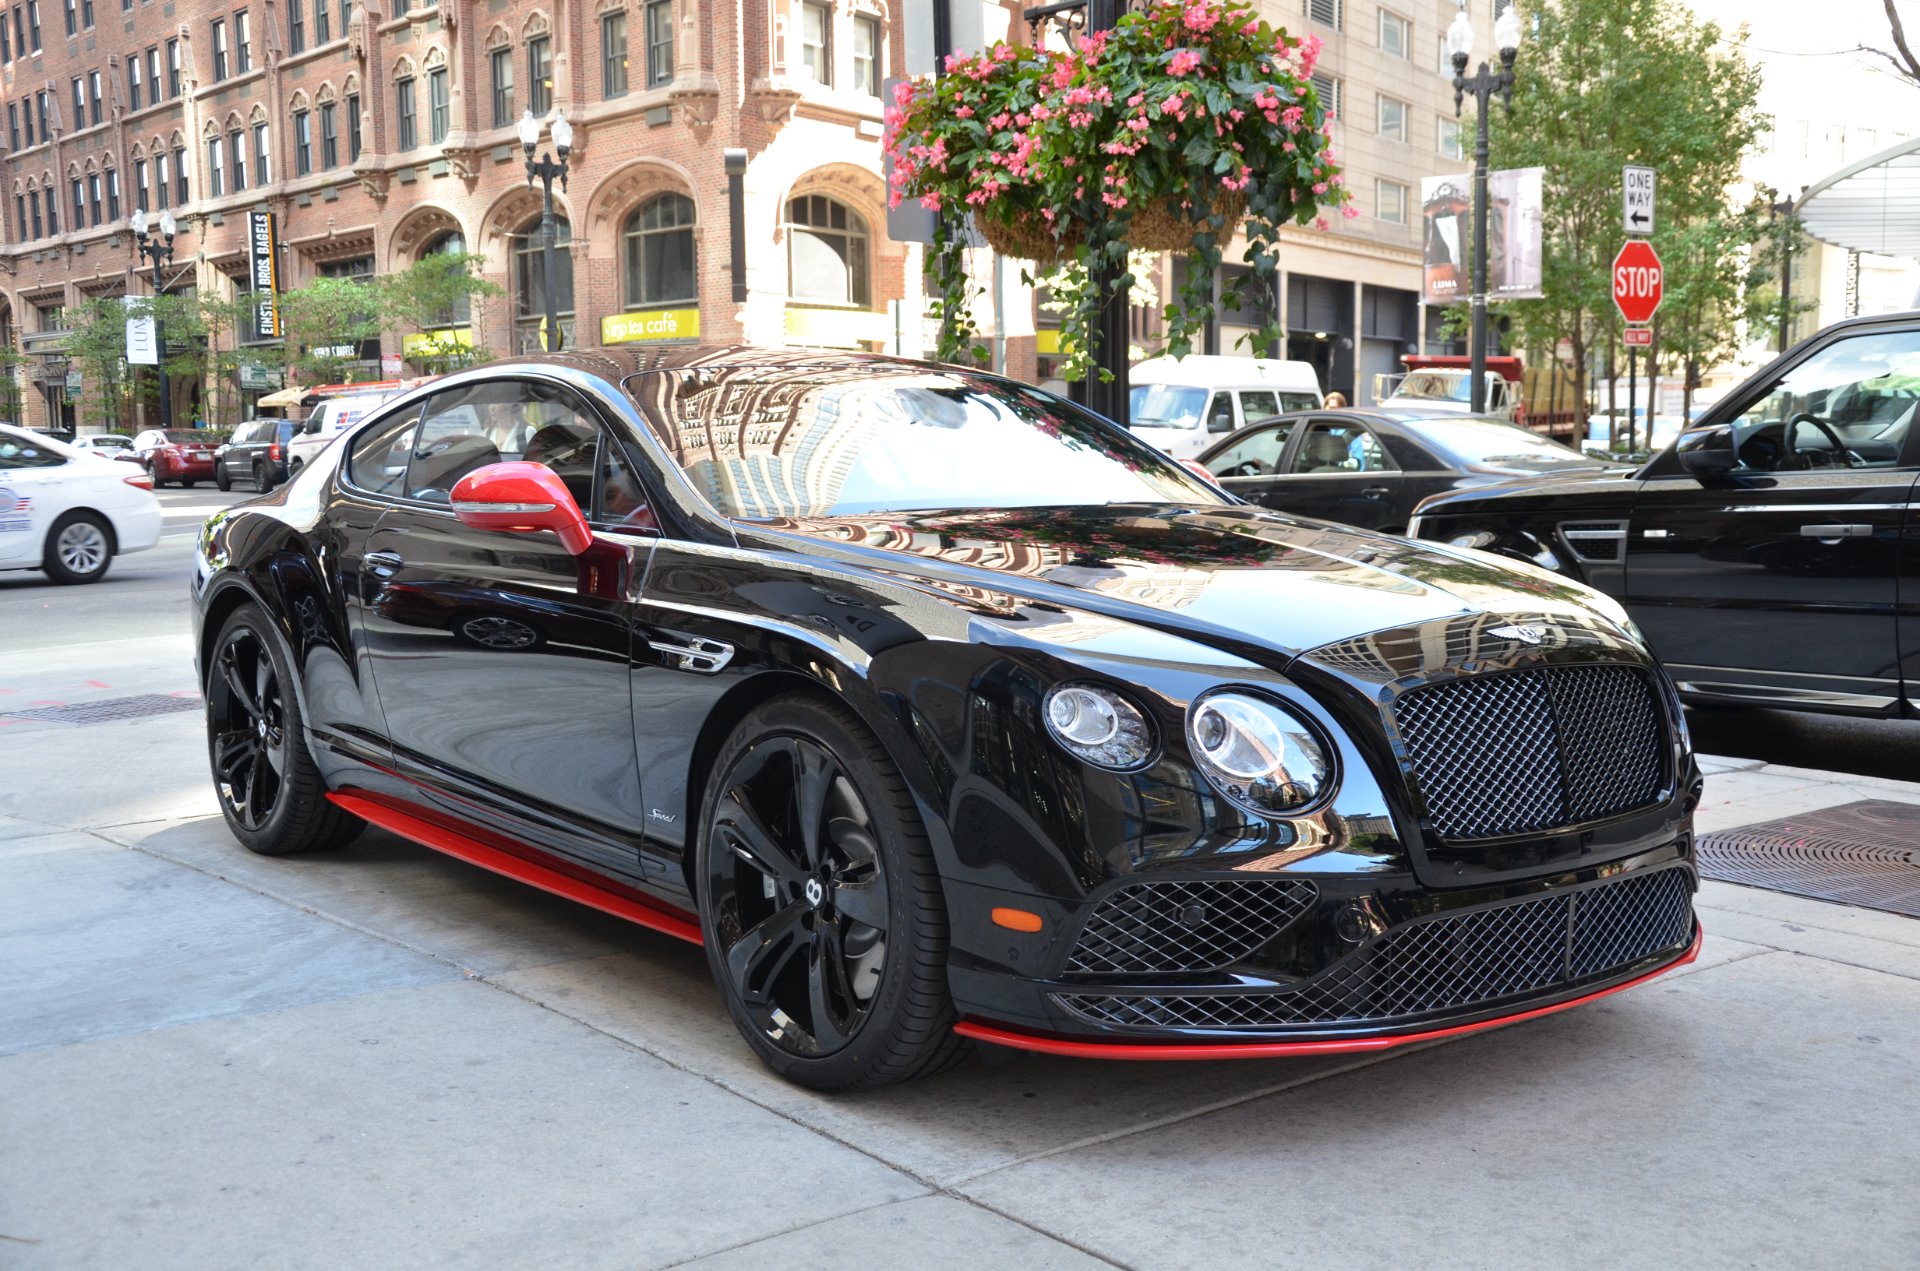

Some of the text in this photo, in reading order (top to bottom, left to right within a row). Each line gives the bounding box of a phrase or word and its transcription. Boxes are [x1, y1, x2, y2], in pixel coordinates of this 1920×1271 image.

[1628, 173, 1651, 189] ONE
[1628, 191, 1651, 207] WAY
[255, 215, 274, 335] EINSTEIN BROS. BAGELS
[1616, 266, 1660, 298] STOP
[1846, 253, 1858, 319] NORDSTROM
[134, 315, 149, 351] LUM
[647, 312, 676, 333] café
